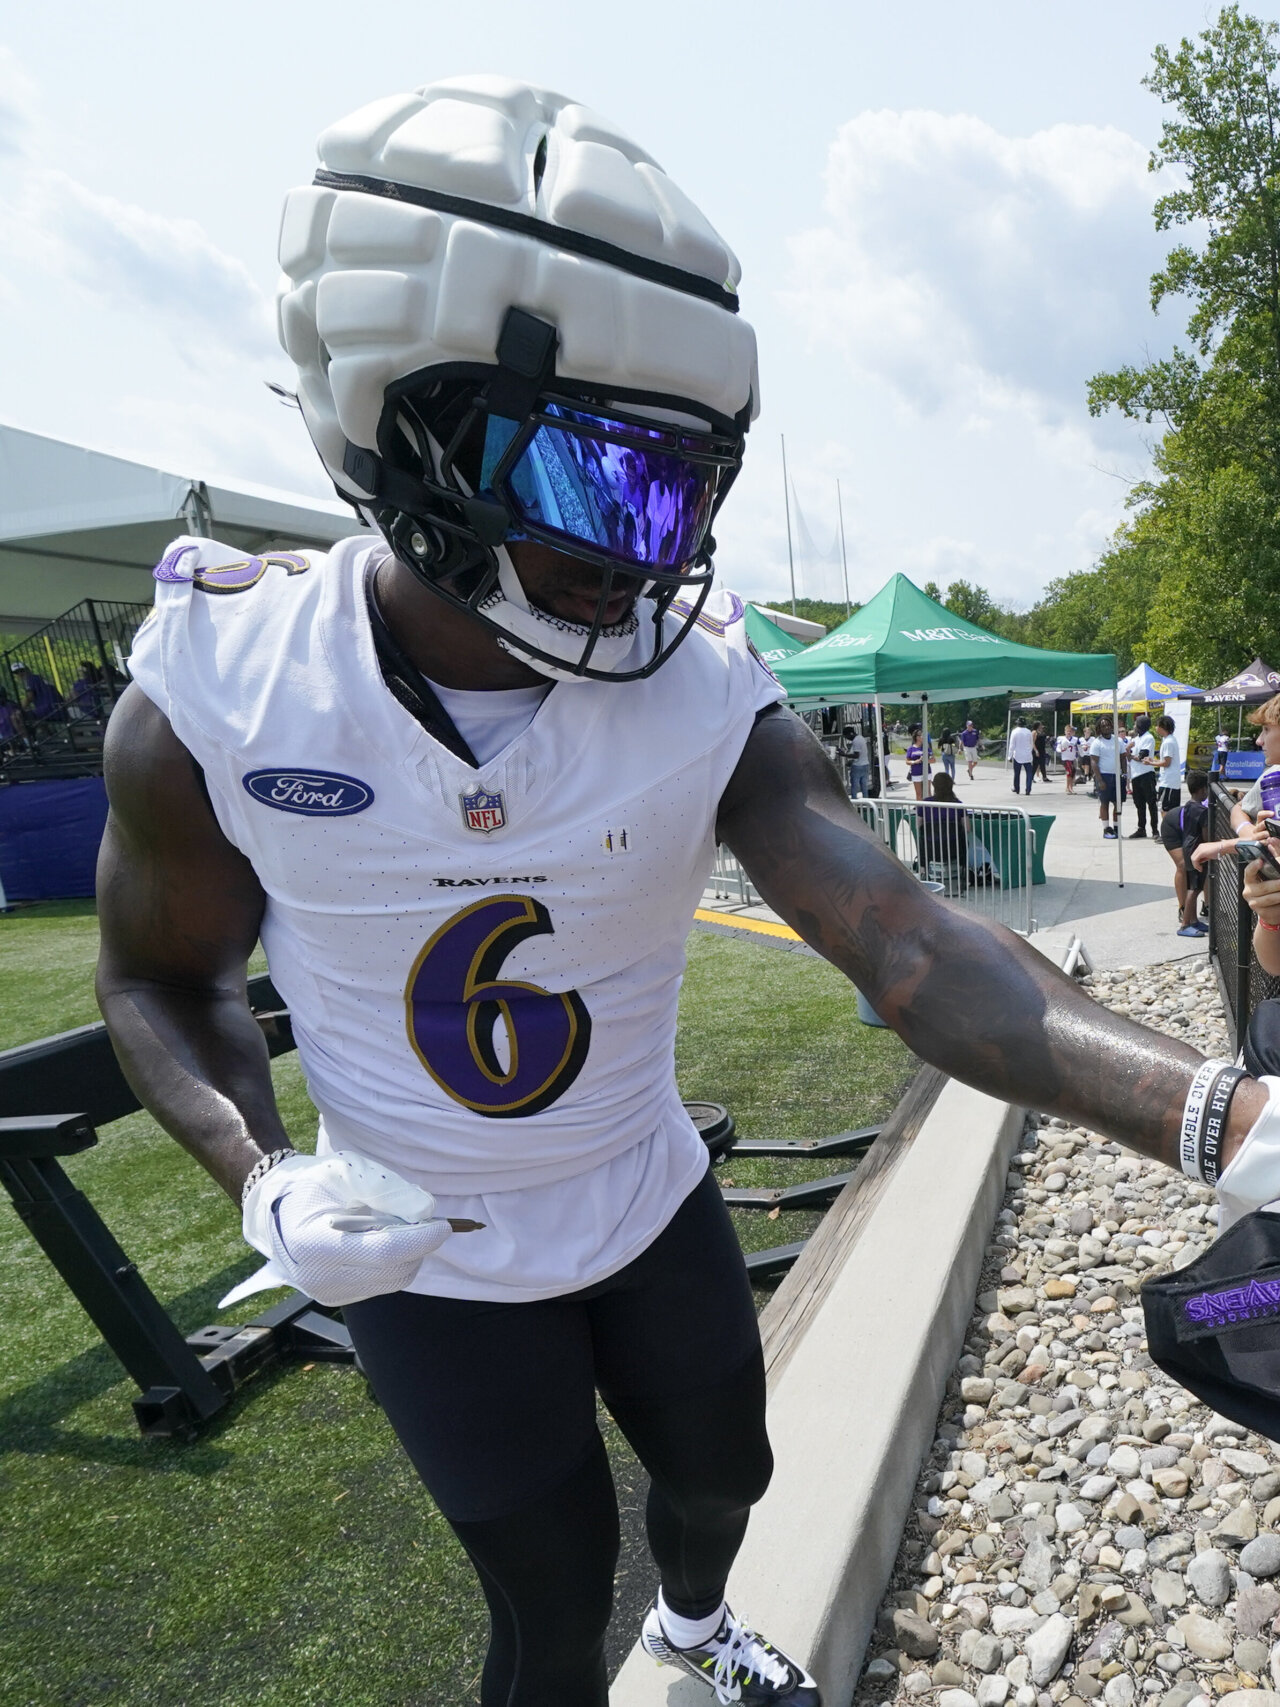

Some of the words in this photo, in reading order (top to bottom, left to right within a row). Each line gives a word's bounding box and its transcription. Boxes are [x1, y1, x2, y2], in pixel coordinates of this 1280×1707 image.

[899, 627, 960, 641] M&T
[953, 628, 1008, 645] Bank
[761, 648, 787, 661] &T
[1204, 694, 1246, 702] RAVENS
[1226, 760, 1264, 768] Constellation
[271, 777, 345, 807] Ford
[469, 810, 502, 829] NFL
[432, 875, 548, 887] RAVENS
[404, 893, 592, 1119] 6
[1191, 1066, 1213, 1100] OVER
[1211, 1074, 1236, 1112] HYPE
[1183, 1105, 1200, 1163] HUMBLE
[1204, 1117, 1221, 1155] OVER
